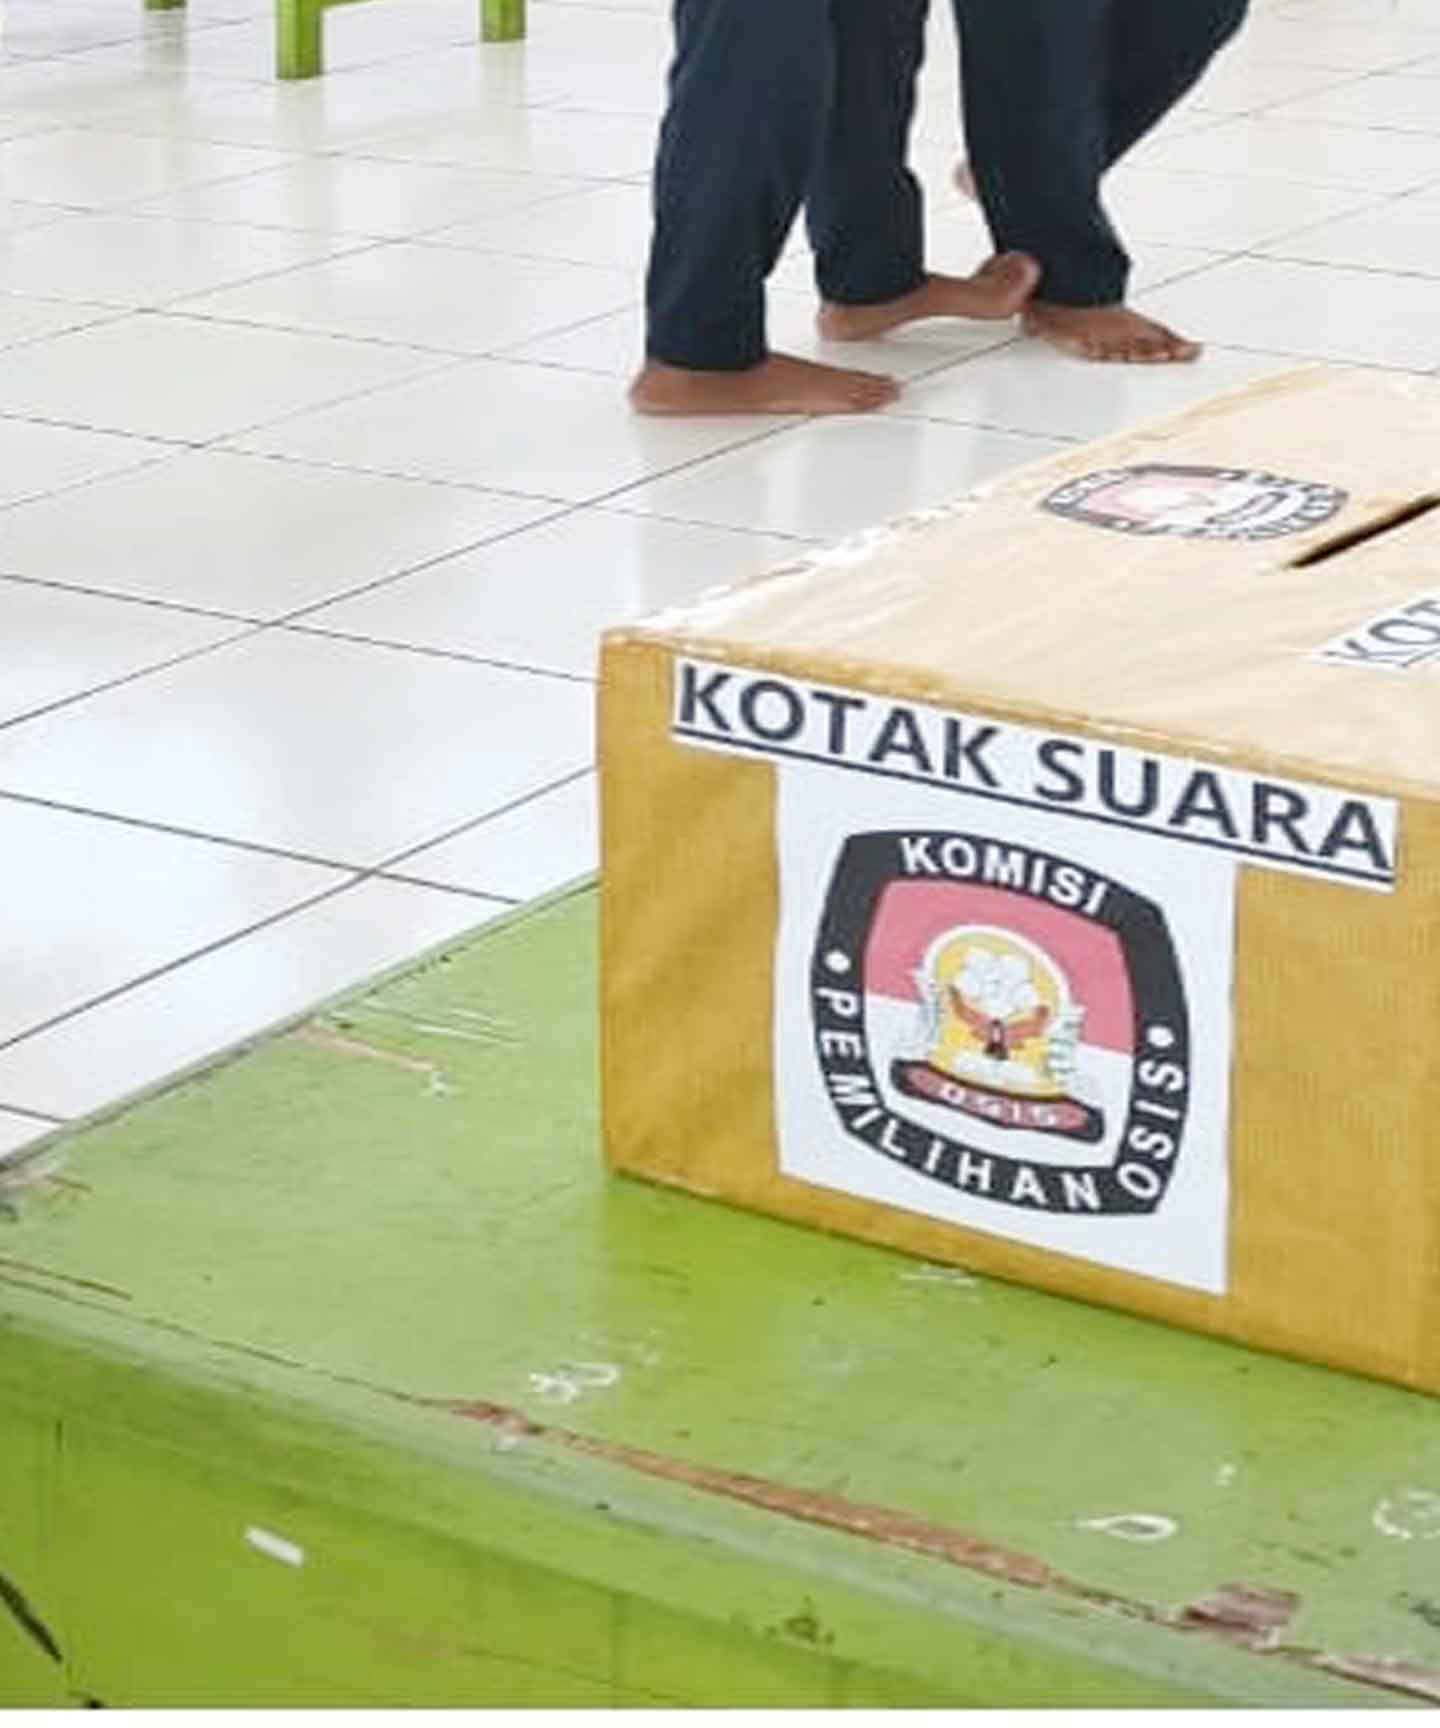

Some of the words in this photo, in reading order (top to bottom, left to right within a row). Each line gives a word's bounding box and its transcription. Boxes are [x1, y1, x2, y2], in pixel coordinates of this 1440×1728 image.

[678, 663, 1002, 788] KOTAK
[1034, 738, 1393, 869] SUARA
[900, 836, 1108, 915] KOMISI
[816, 986, 1101, 1210] PEMILIHAN
[1117, 1058, 1185, 1200] OSIS
